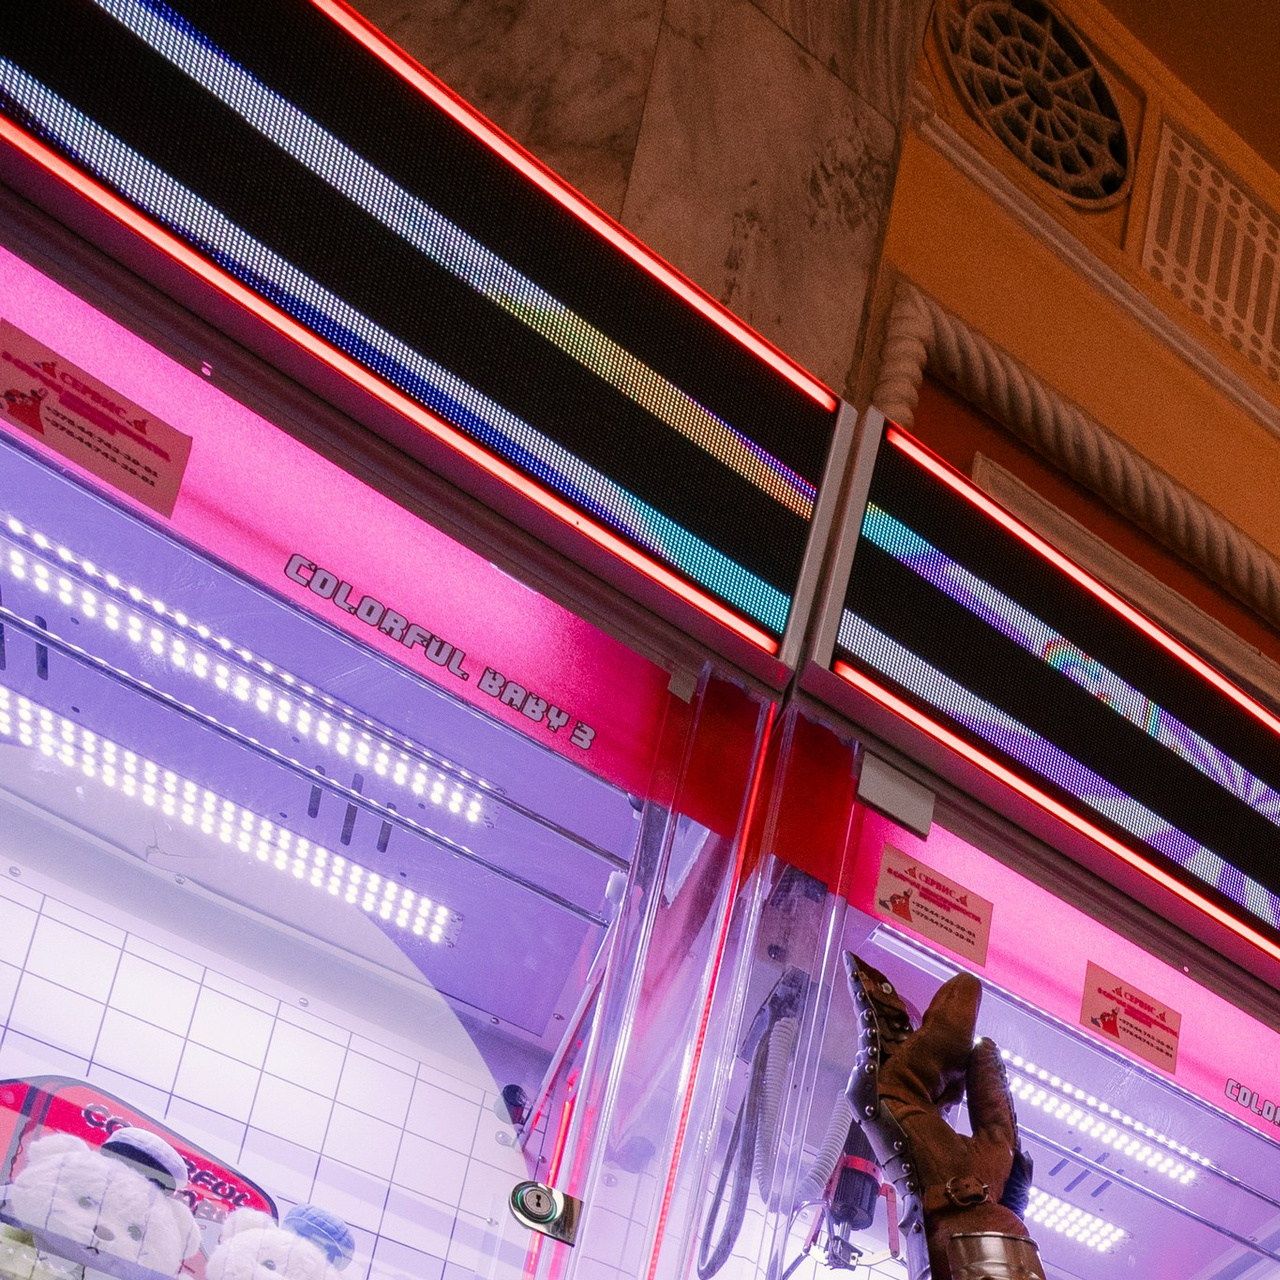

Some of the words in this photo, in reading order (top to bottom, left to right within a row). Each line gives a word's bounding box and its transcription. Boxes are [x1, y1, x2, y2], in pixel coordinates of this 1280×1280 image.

[60, 372, 127, 417] СЕРВИС
[284, 553, 469, 681] COLORFUL
[477, 666, 571, 733] BABY
[570, 720, 597, 750] 3
[919, 873, 957, 897] СЕРВИС
